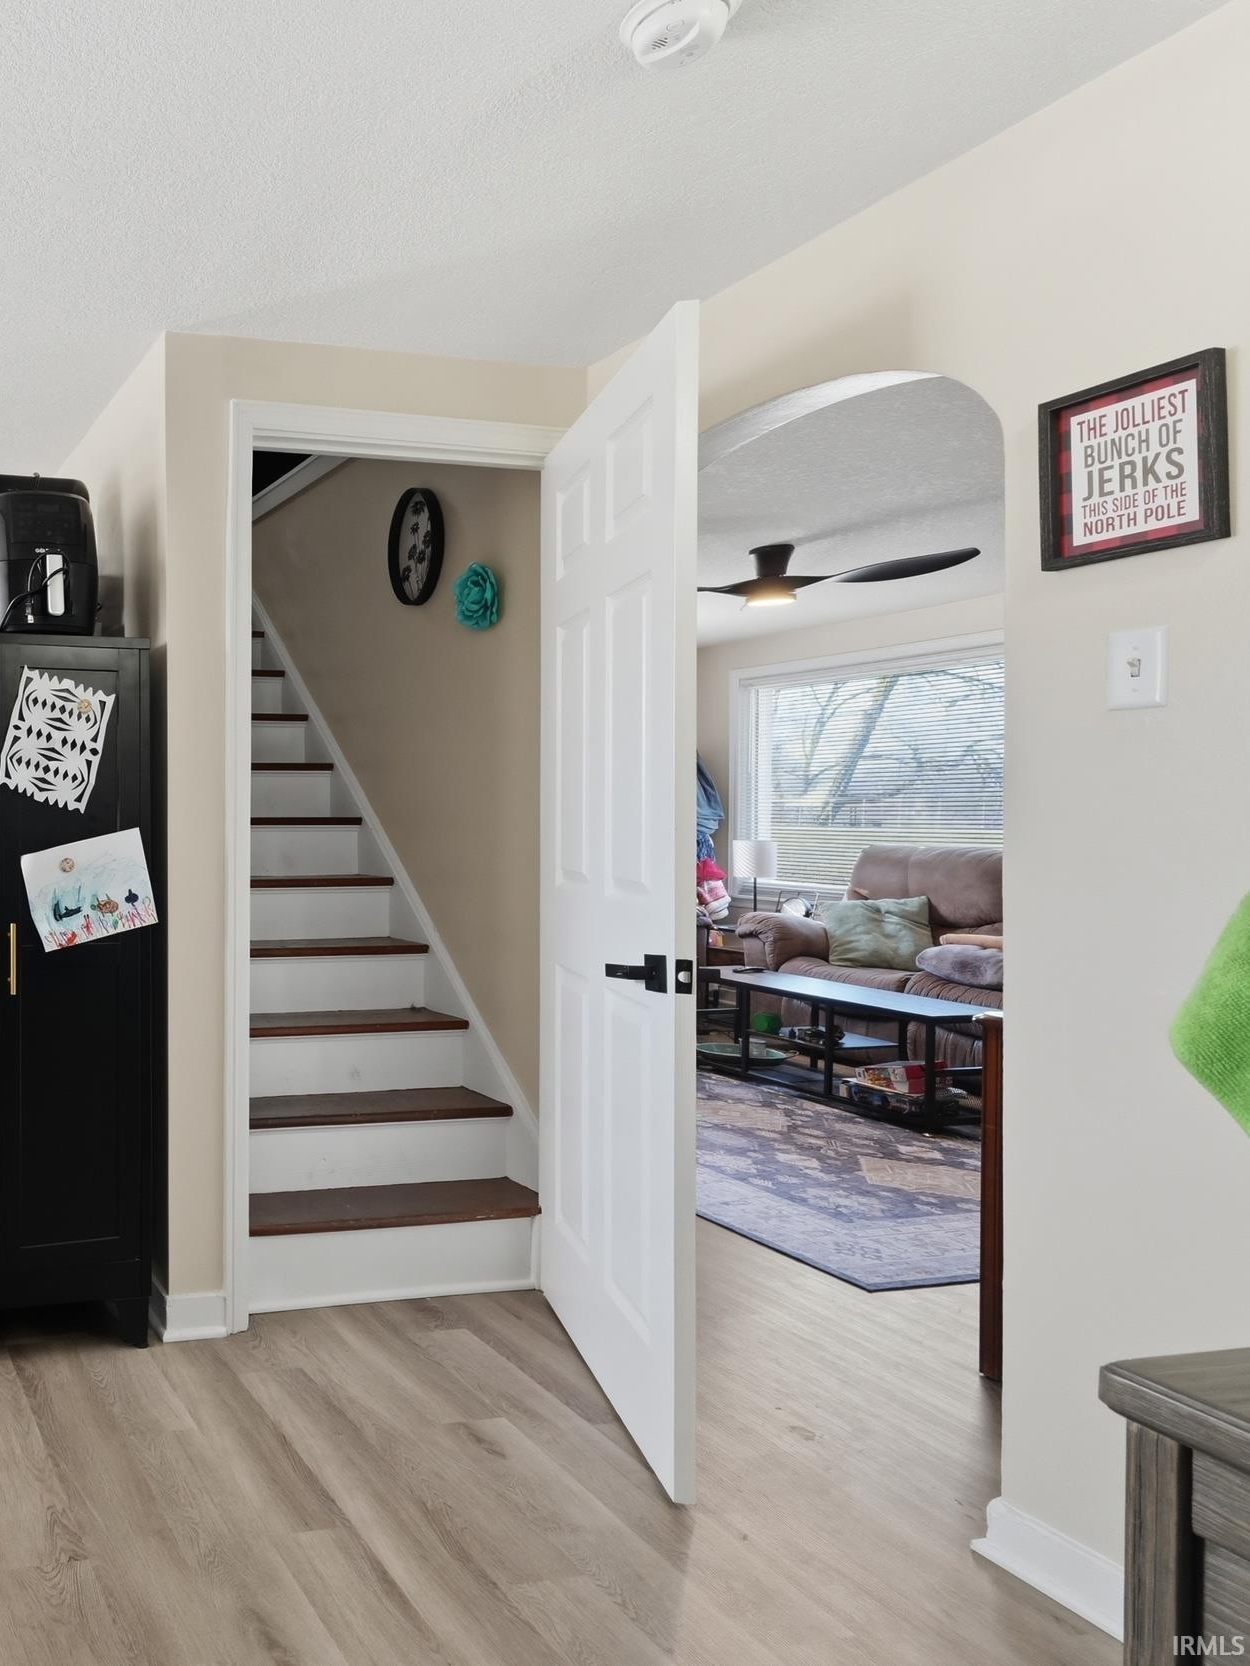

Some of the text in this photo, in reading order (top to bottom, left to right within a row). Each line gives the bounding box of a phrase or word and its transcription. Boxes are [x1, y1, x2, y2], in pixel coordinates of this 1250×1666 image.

[1076, 389, 1188, 443] THE JOLLIEST
[1083, 418, 1183, 469] BUNCH OF
[1081, 481, 1187, 519] THIS SIDE OF THE
[1082, 447, 1185, 502] JERKS
[1083, 499, 1187, 537] NORTH POLE
